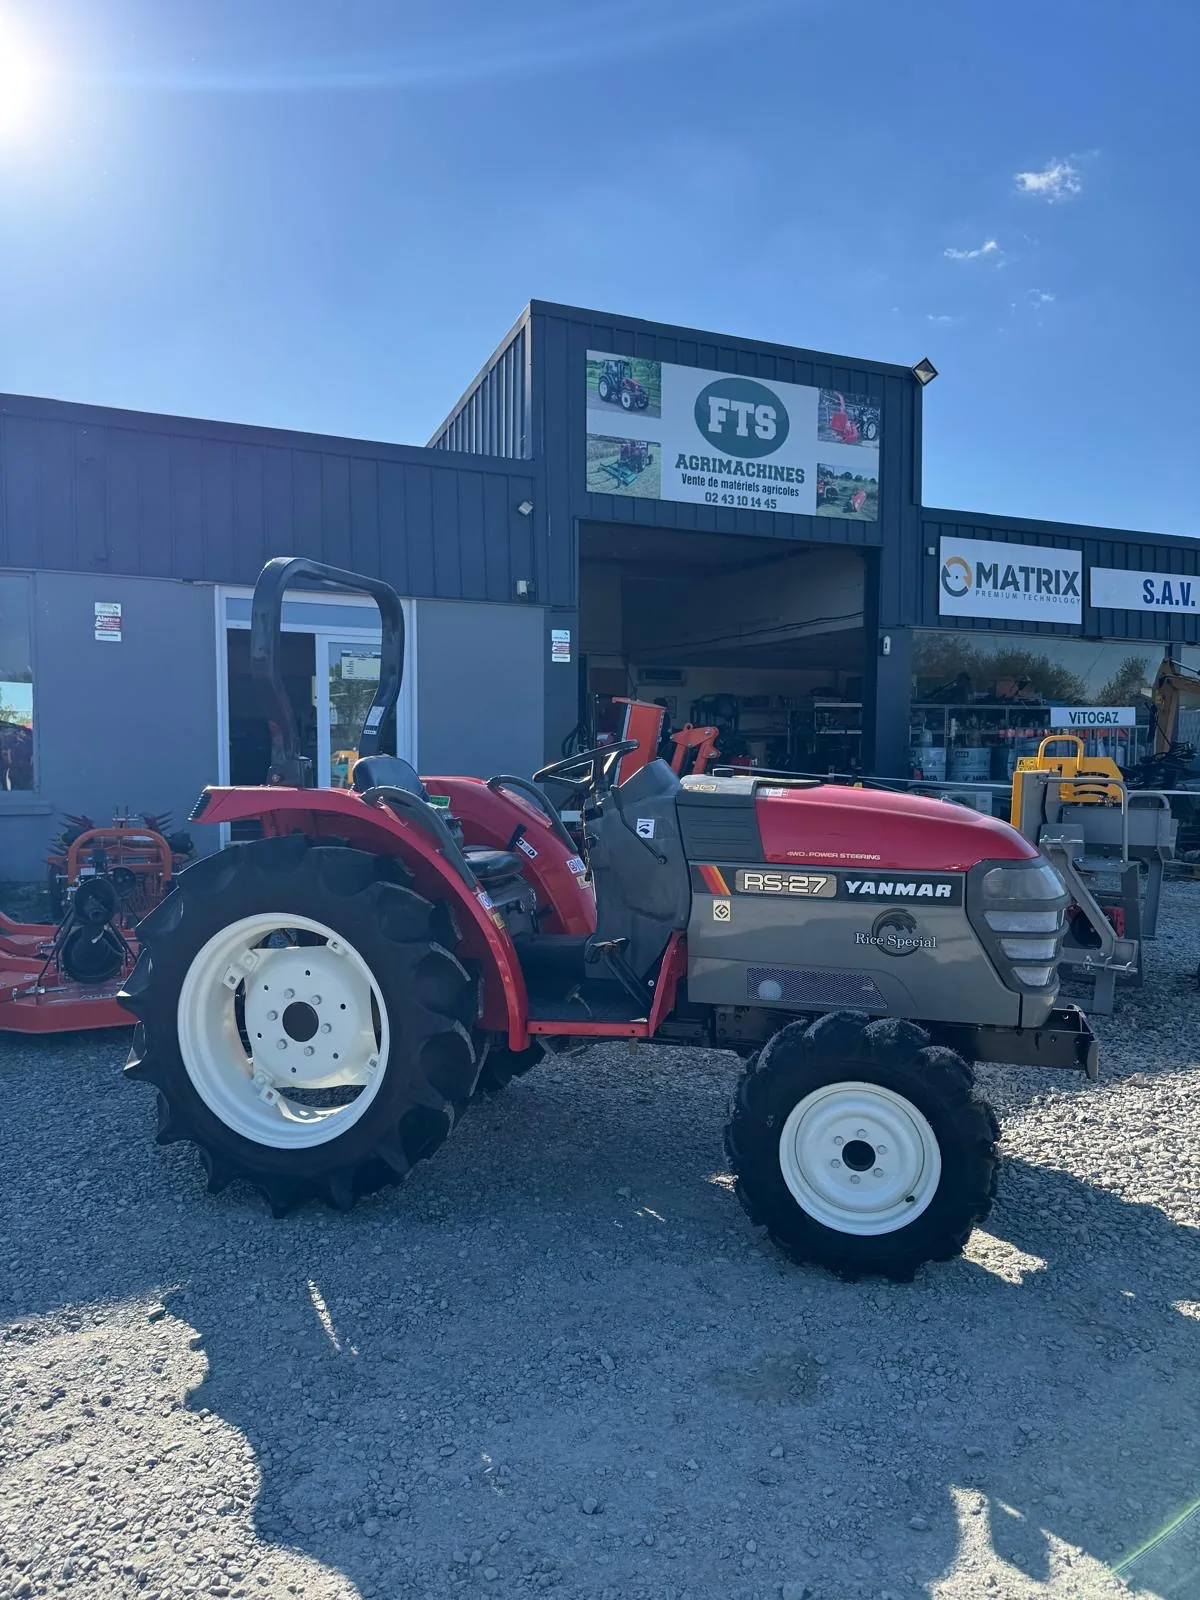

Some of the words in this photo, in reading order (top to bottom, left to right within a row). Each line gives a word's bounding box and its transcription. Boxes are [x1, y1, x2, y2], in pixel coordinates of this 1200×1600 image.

[707, 396, 777, 440] FTS
[675, 453, 805, 484] AGRIMACHINES
[681, 473, 706, 487] Vente
[707, 476, 719, 488] de
[720, 479, 760, 493] matériels
[762, 484, 800, 497] agricoles
[705, 492, 718, 504] 02
[721, 494, 735, 505] 43
[737, 495, 748, 507] 10
[751, 497, 762, 508] 14
[764, 499, 777, 510] 45
[976, 561, 1080, 597] MATRIX
[975, 590, 1018, 600] PREMIUM
[1023, 594, 1080, 605] TECHNOLOGY
[1142, 578, 1196, 607] S.A.V.
[840, 852, 881, 861] STEERING
[743, 873, 828, 895] RS-27
[845, 880, 952, 898] YANMAR
[855, 932, 884, 946] Rice
[887, 933, 937, 948] Special
